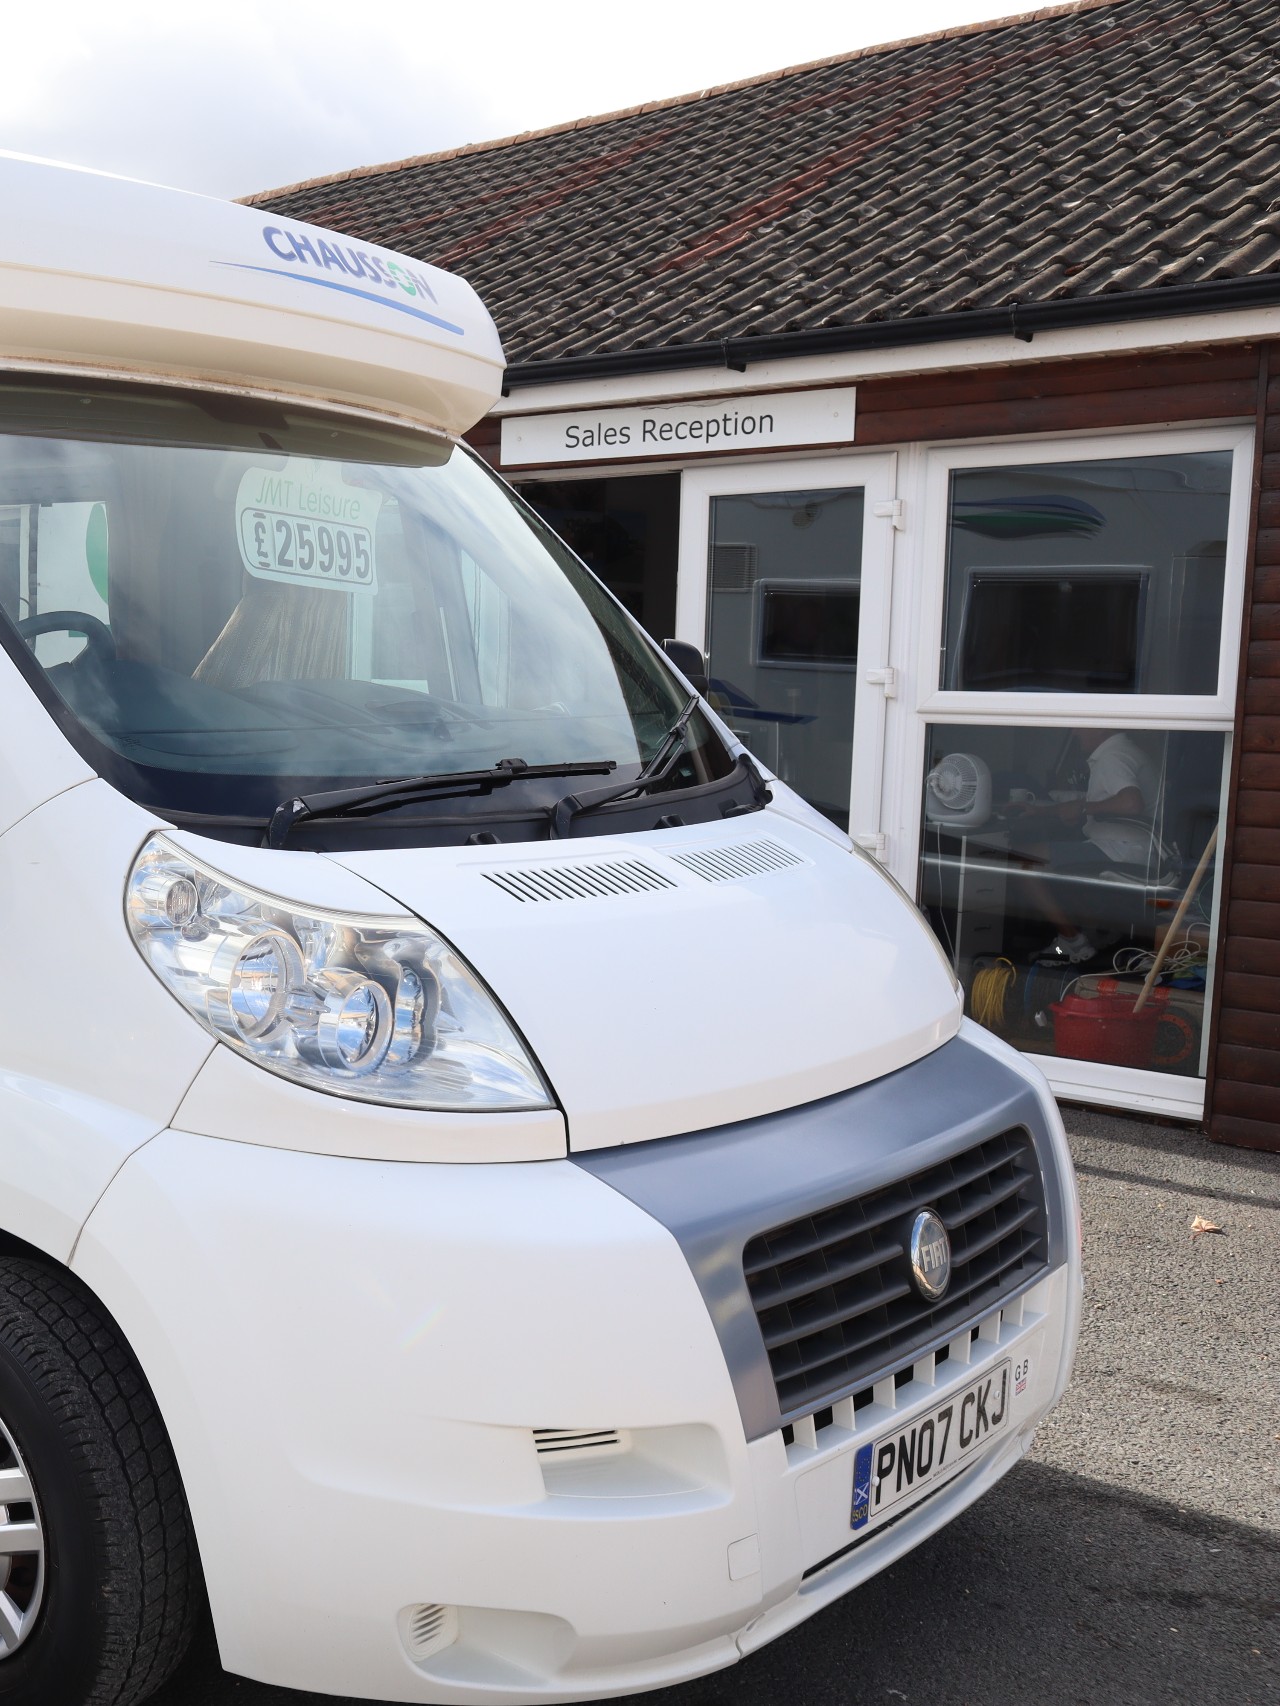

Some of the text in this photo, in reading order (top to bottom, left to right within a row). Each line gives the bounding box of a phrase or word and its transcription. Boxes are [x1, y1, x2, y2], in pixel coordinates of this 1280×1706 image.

[262, 226, 438, 305] CHAUSSON
[565, 411, 774, 448] Sales Reception
[255, 476, 361, 520] JMT Leisure
[921, 1238, 946, 1272] FIAT
[875, 1368, 1008, 1506] PN07 CKJ
